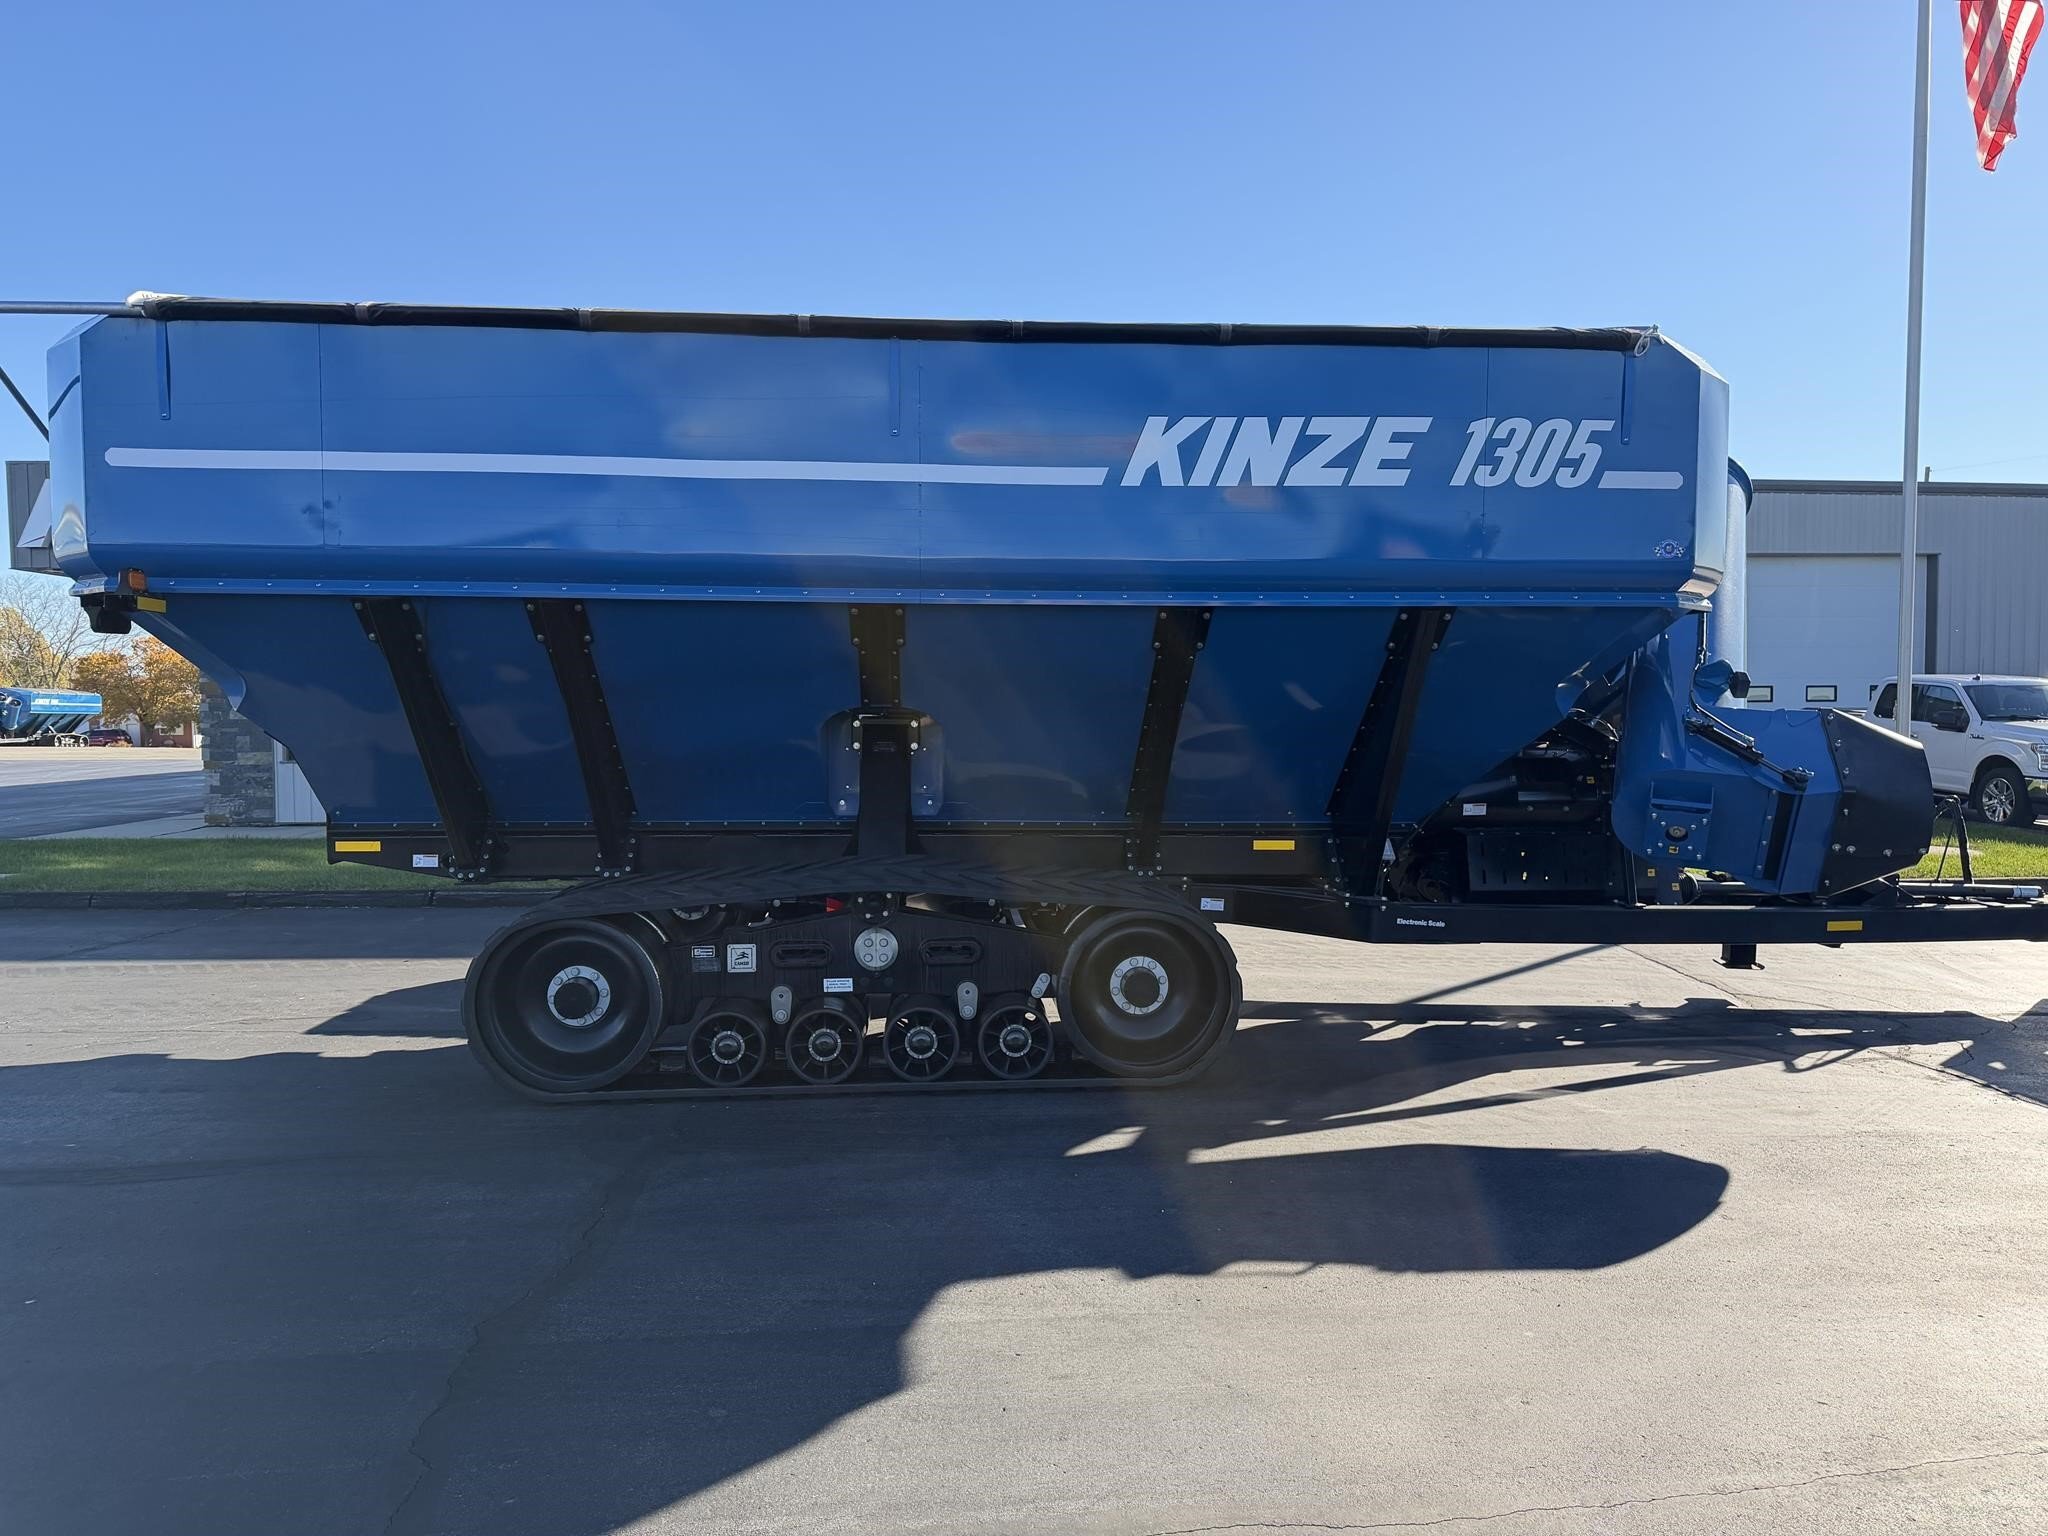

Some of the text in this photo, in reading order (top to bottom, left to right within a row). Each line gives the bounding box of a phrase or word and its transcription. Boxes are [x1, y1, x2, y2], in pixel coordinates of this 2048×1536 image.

[1120, 416, 1616, 488] KINZE 1305
[1396, 918, 1446, 928] Electronic Scale
